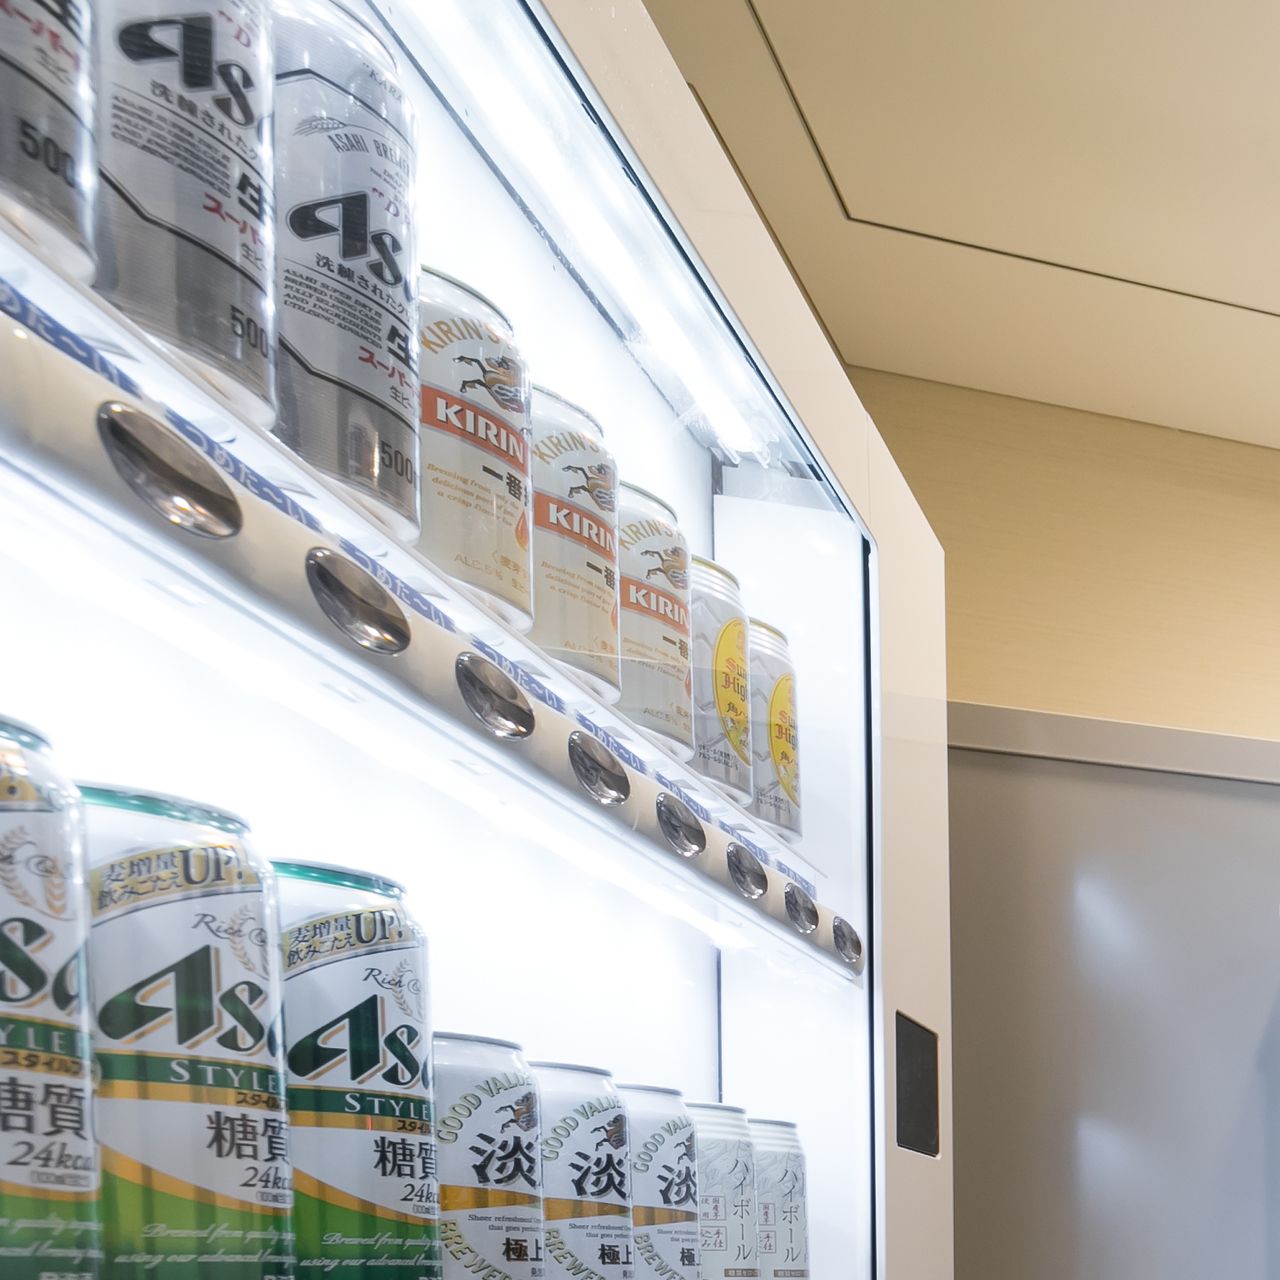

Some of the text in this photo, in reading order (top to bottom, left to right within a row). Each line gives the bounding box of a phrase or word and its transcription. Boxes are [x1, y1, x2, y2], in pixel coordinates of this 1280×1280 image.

[436, 397, 525, 465] KIRIN
[549, 502, 617, 552] KIRIN
[629, 584, 690, 629] KIRIN
[353, 909, 404, 945] UP!
[170, 1059, 279, 1094] STYLE
[345, 1093, 430, 1122] STYLE
[437, 1092, 483, 1145] GOOD
[206, 1110, 290, 1164] 糖質
[374, 1136, 439, 1182] 糖質
[540, 1114, 579, 1162] GOOD
[633, 1132, 667, 1174] GOOD
[728, 1158, 754, 1263] ハイボール
[777, 1168, 802, 1264] ハイボール
[503, 1237, 543, 1263] 極上
